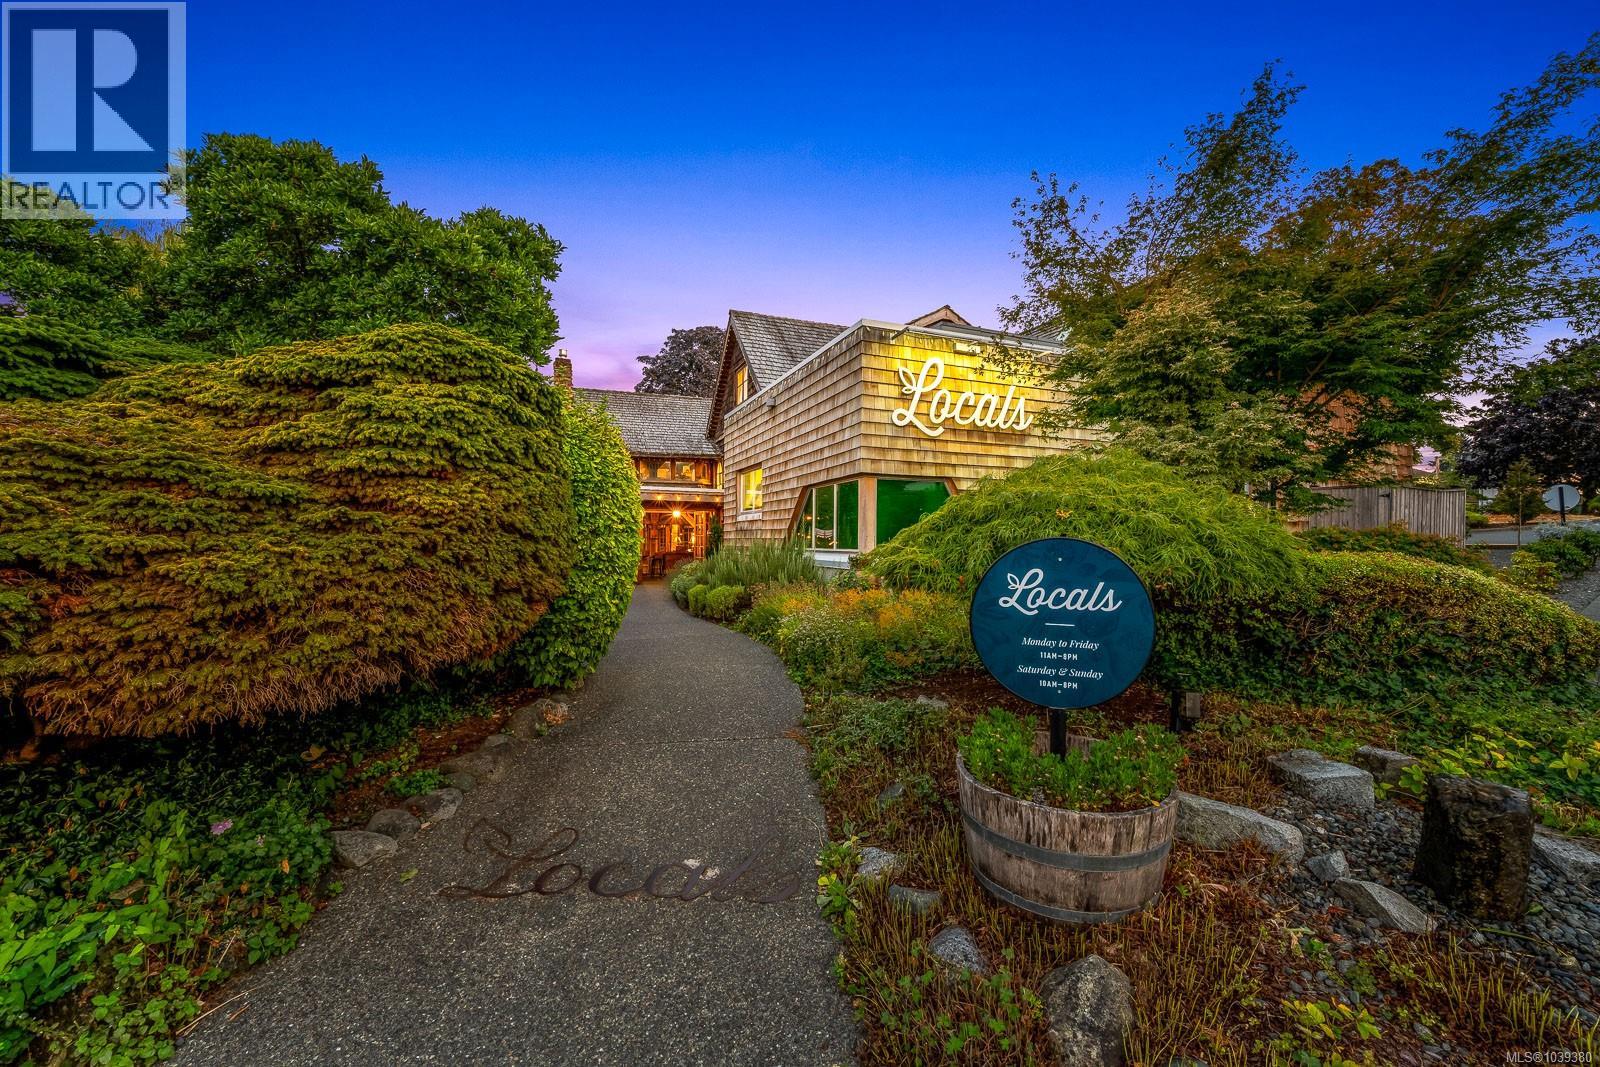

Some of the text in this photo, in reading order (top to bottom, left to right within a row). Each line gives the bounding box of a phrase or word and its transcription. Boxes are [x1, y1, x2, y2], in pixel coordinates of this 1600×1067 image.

[891, 357, 1035, 437] Locals
[998, 568, 1123, 616] Locals
[1021, 637, 1100, 651] Monday to Friday
[1016, 664, 1104, 680] Saturday & Sunday
[439, 818, 799, 904] Locals
